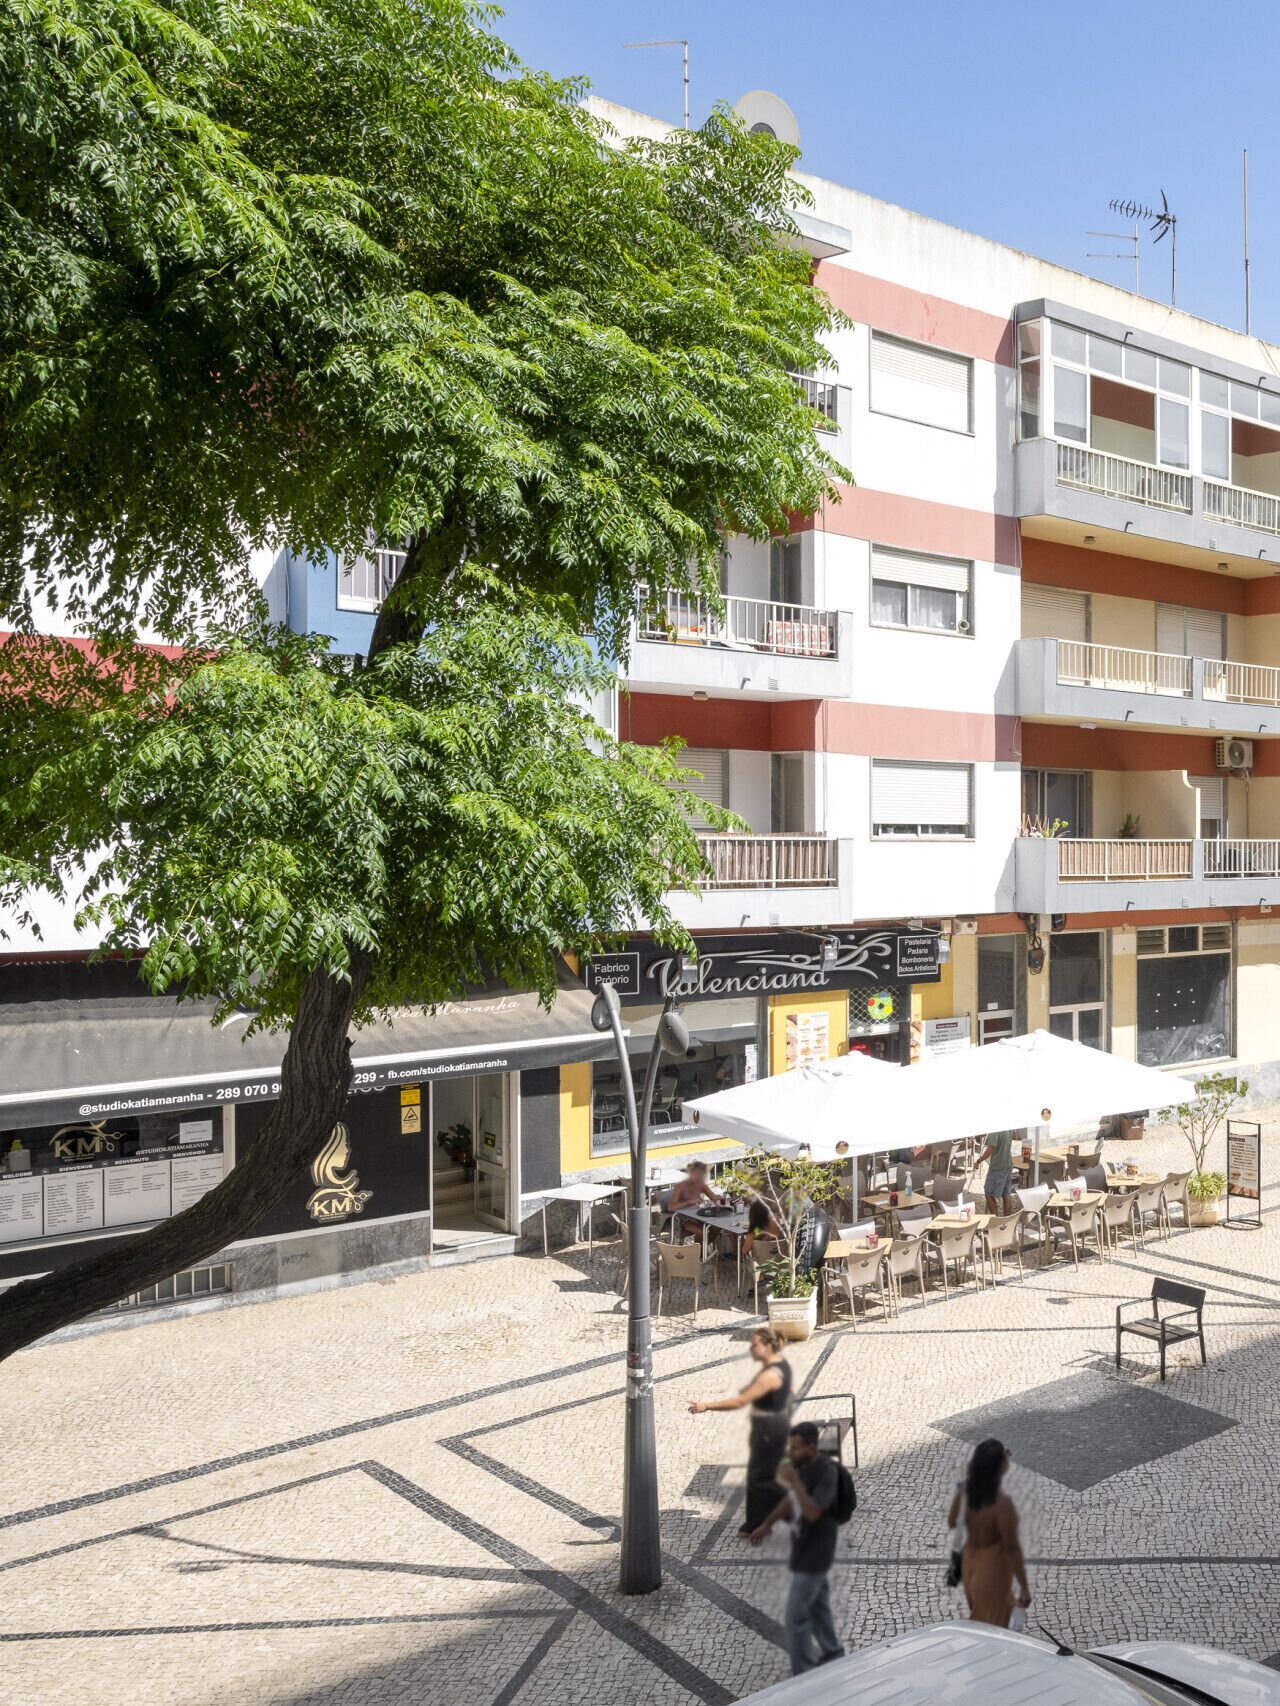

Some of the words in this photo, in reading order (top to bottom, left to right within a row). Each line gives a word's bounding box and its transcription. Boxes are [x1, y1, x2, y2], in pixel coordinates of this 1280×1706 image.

[901, 956, 934, 964] Bomboneria
[594, 962, 630, 973] Fabrico
[595, 974, 629, 986] Próprio
[646, 957, 831, 997] Valenciana
[354, 1072, 377, 1084] 299
[387, 1058, 508, 1080] fb.com/studiokatiamaranha
[79, 1092, 204, 1116] @studiokatiamaranha
[216, 1087, 241, 1100] 289
[244, 1084, 269, 1097] 070
[54, 1136, 101, 1158] KM
[172, 1149, 206, 1158] BIENVENIDO
[114, 1157, 150, 1165] BENVENUTO
[59, 1163, 93, 1172] BIENVENUE
[2, 1170, 33, 1179] WELCOME
[313, 1197, 350, 1217] KM
